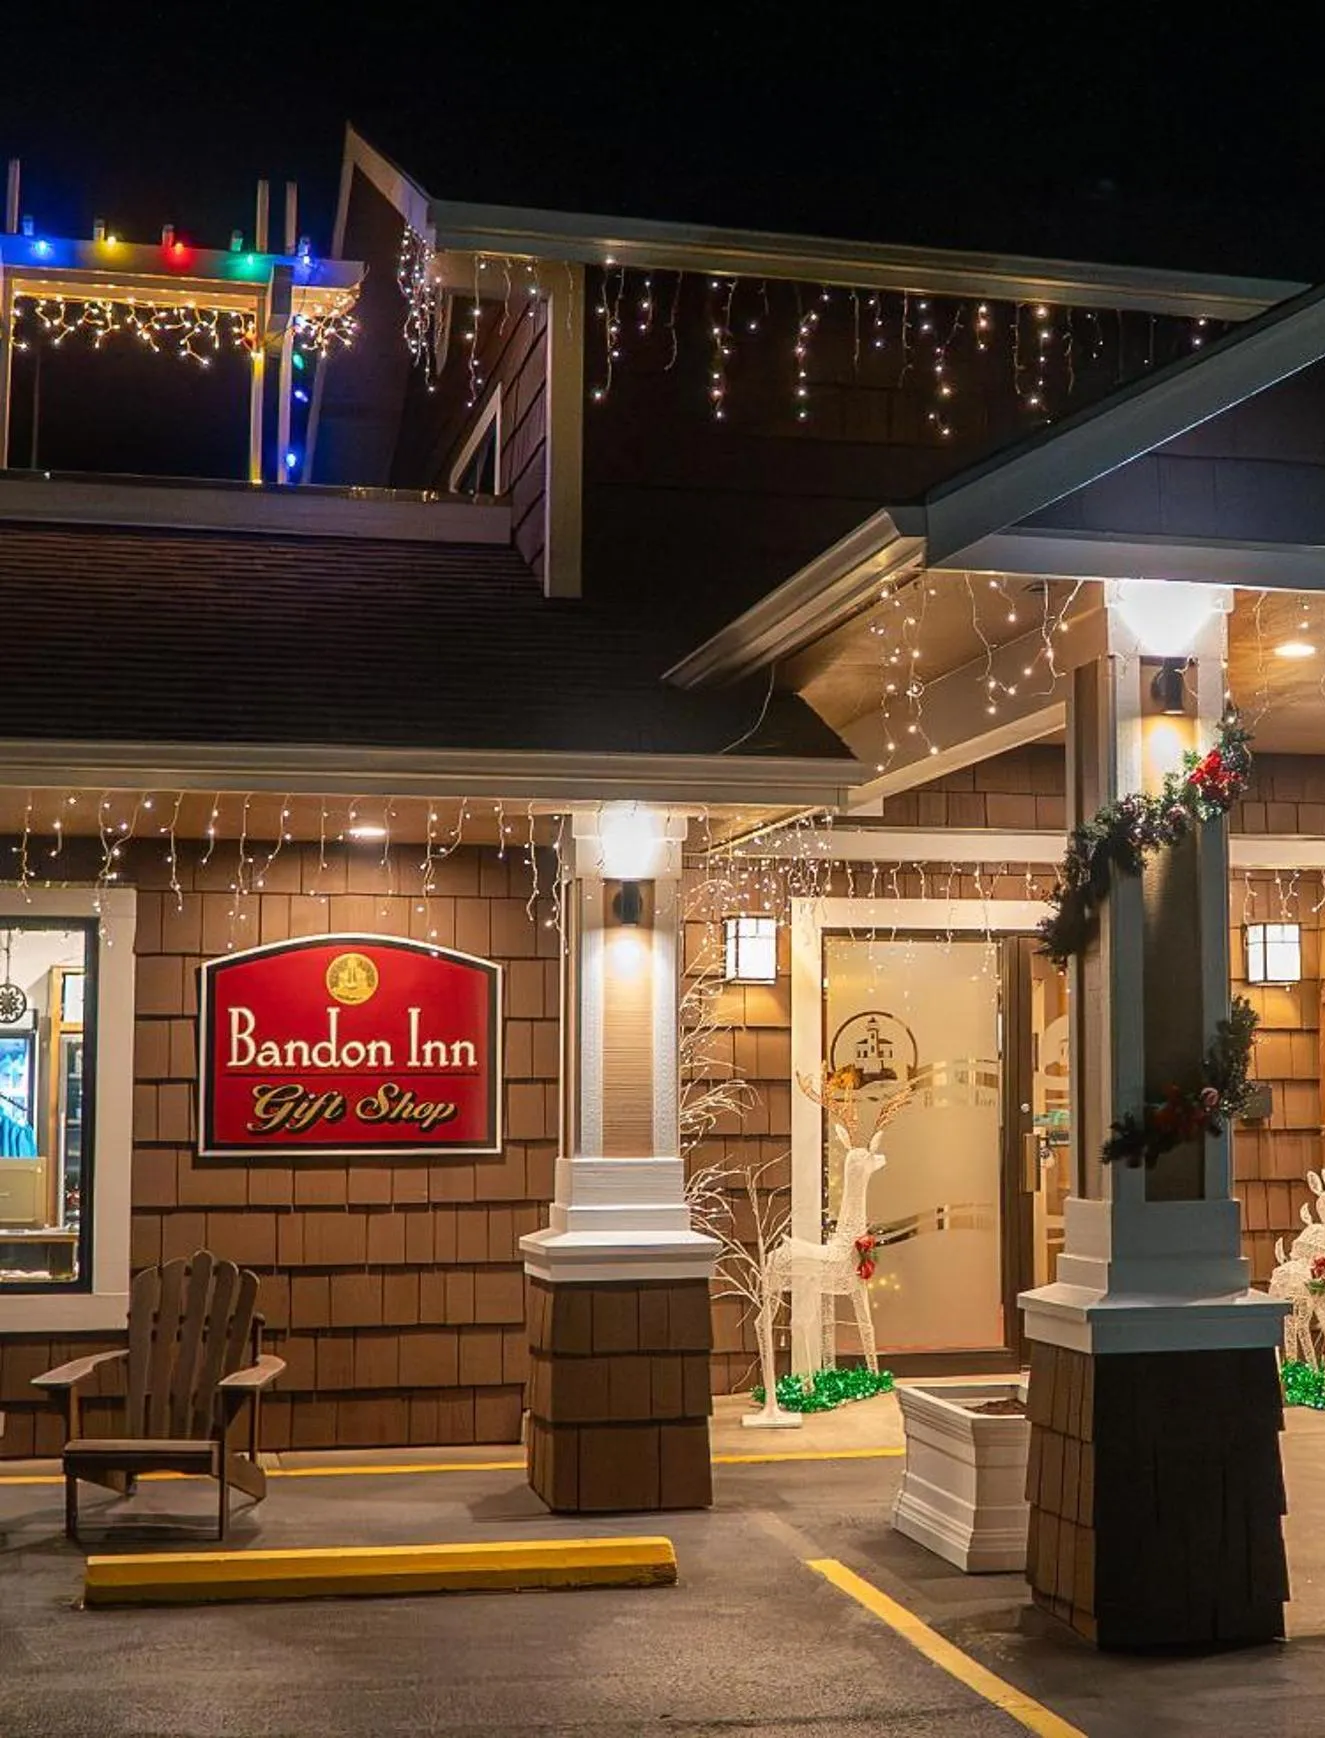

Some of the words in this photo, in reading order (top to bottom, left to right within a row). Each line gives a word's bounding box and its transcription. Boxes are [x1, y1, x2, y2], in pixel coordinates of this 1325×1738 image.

[227, 1007, 394, 1067] Bandon
[407, 1007, 477, 1067] Inn
[247, 1084, 345, 1132] Gift
[356, 1083, 455, 1130] Shop
